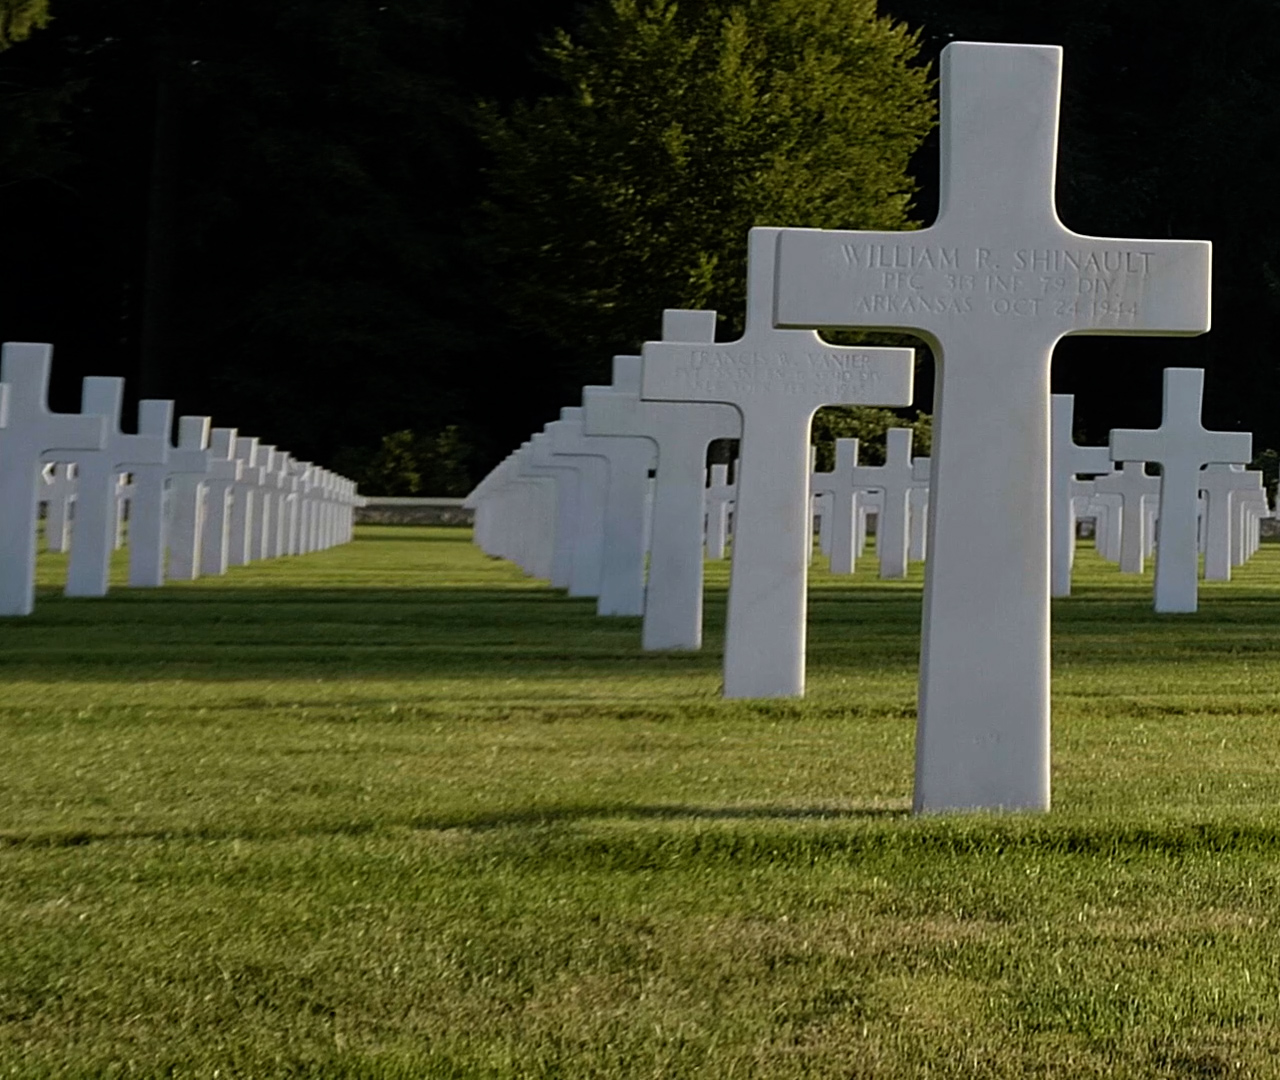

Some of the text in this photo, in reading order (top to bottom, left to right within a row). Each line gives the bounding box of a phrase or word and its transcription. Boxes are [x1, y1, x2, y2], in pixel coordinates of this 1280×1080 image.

[841, 244, 1156, 274] WILLIAM R. SHINAULT
[882, 272, 924, 290] PFC
[985, 275, 1023, 293] INF
[1040, 276, 1066, 294] 79
[856, 295, 1139, 320] ARKANSAS OCT 24 1944
[804, 352, 869, 370] VANIER
